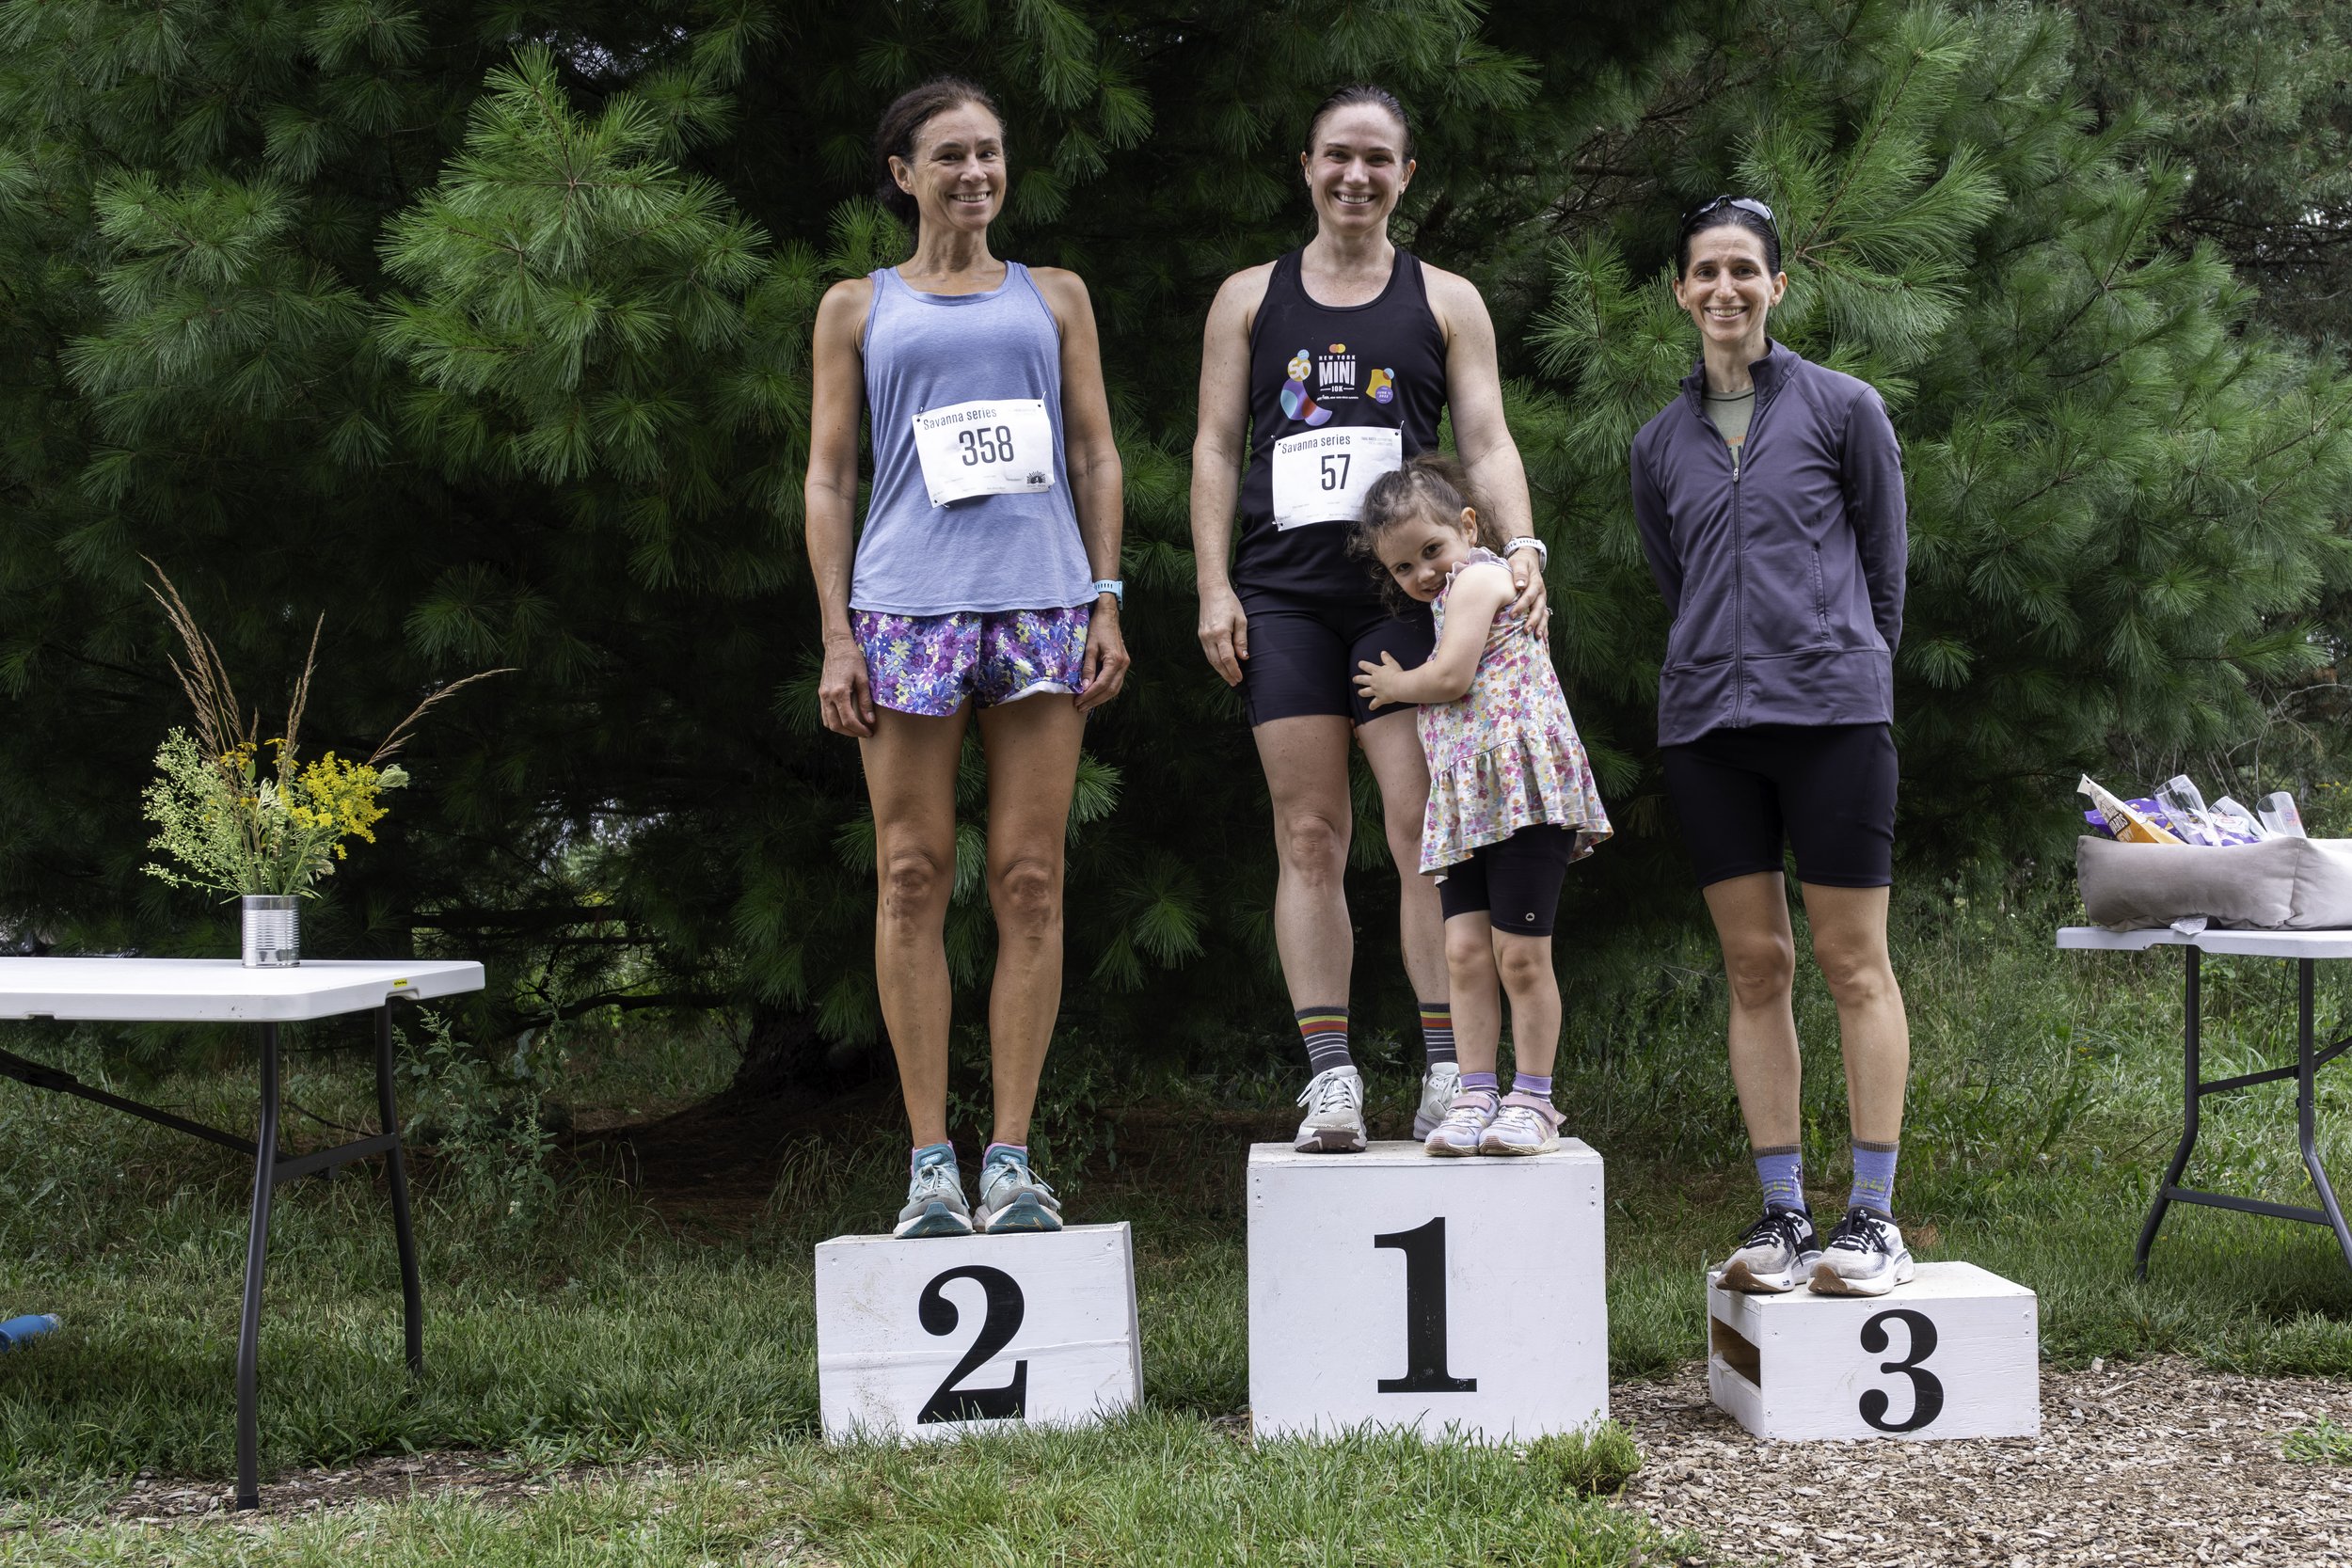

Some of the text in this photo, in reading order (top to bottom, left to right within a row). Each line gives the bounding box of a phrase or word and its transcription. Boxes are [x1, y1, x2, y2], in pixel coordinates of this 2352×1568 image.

[1288, 358, 1311, 381] 50
[1318, 361, 1356, 388] MINI
[923, 407, 997, 431] Savanna series
[959, 425, 1014, 467] 358
[1281, 435, 1351, 454] Savanna series
[1321, 453, 1351, 491] 57
[1374, 1216, 1478, 1394] 1
[916, 1264, 1028, 1425] 2
[1858, 1308, 1945, 1433] 3
